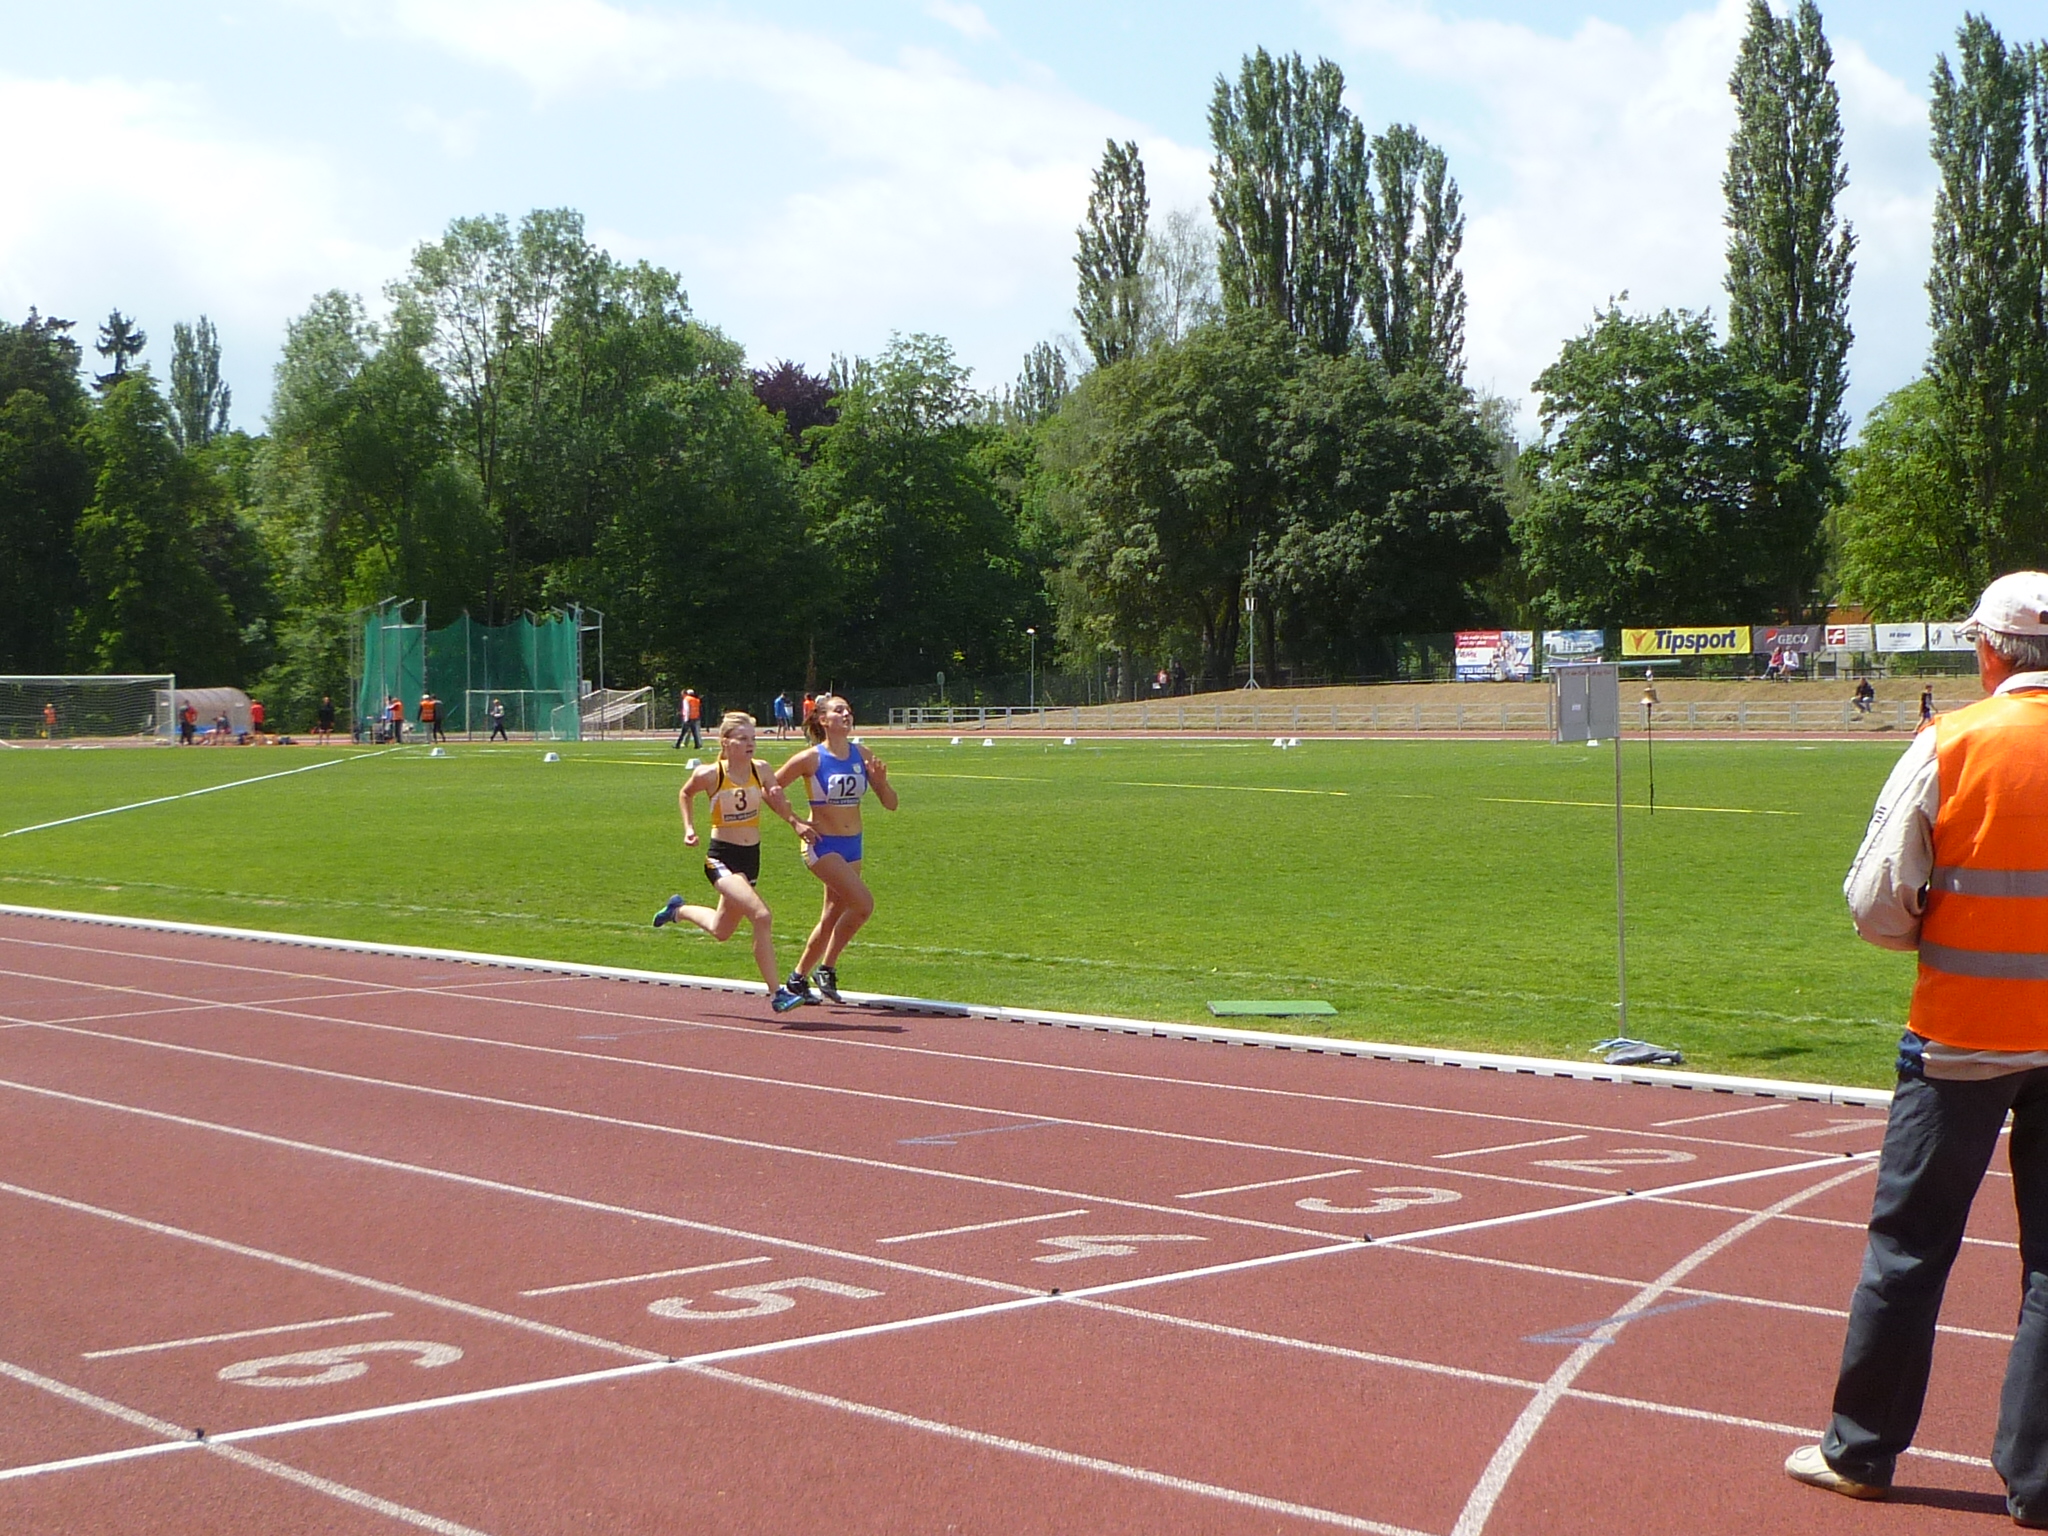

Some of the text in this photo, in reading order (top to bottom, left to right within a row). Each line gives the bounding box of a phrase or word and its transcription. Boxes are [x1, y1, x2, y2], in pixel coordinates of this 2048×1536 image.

[1655, 630, 1736, 654] Tipsport
[1778, 633, 1808, 645] GECO
[734, 788, 748, 812] 3
[837, 776, 857, 797] 12
[1529, 1148, 1698, 1175] 2
[1295, 1186, 1463, 1214] 3
[1030, 1234, 1210, 1264] 4
[647, 1276, 886, 1320] 5
[216, 1340, 465, 1388] 6
